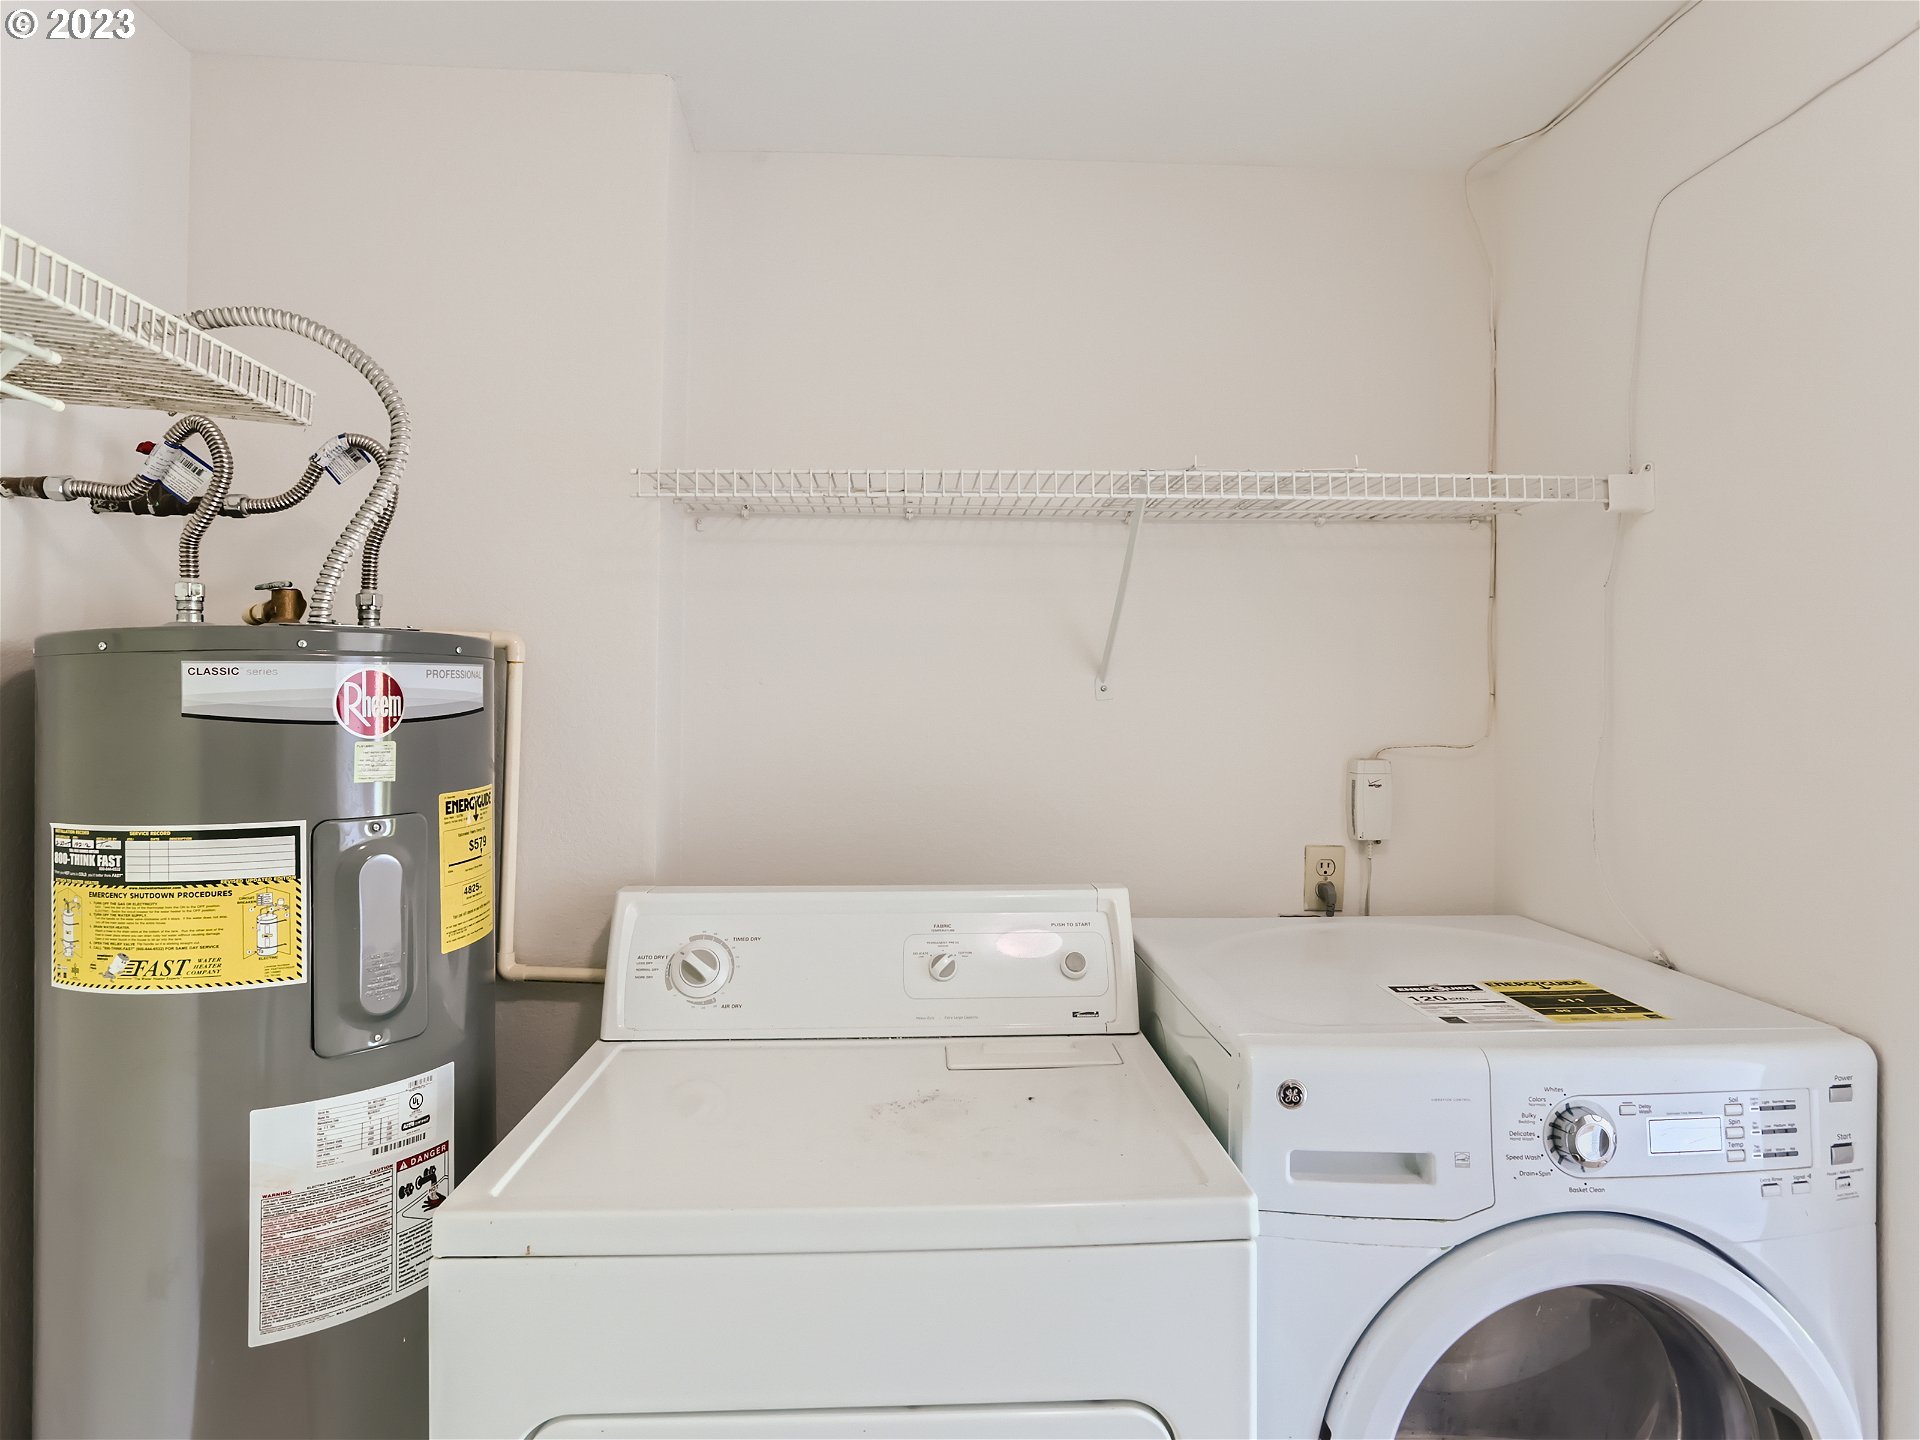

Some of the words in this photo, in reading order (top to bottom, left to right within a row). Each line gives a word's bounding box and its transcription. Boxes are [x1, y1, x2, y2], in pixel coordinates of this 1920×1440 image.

[187, 666, 240, 676] CLASSIC
[246, 667, 279, 676] series
[425, 669, 483, 680] PROFESSIONAL
[343, 672, 402, 727] Rheem
[469, 835, 487, 852] $579
[54, 852, 96, 867] 800-THINK
[97, 855, 122, 867] FAST
[88, 891, 128, 899] EMERGENCY
[177, 890, 233, 898] PROCEDURES
[464, 883, 480, 895] 4825
[124, 959, 191, 977] FAST
[1728, 1141, 1744, 1149] Temp
[410, 1144, 447, 1166] DANGER
[369, 1164, 393, 1175] CAUTION
[306, 1182, 326, 1190] ELECTRIC
[428, 1184, 439, 1193] HOT
[262, 1190, 292, 1199] WARNING
